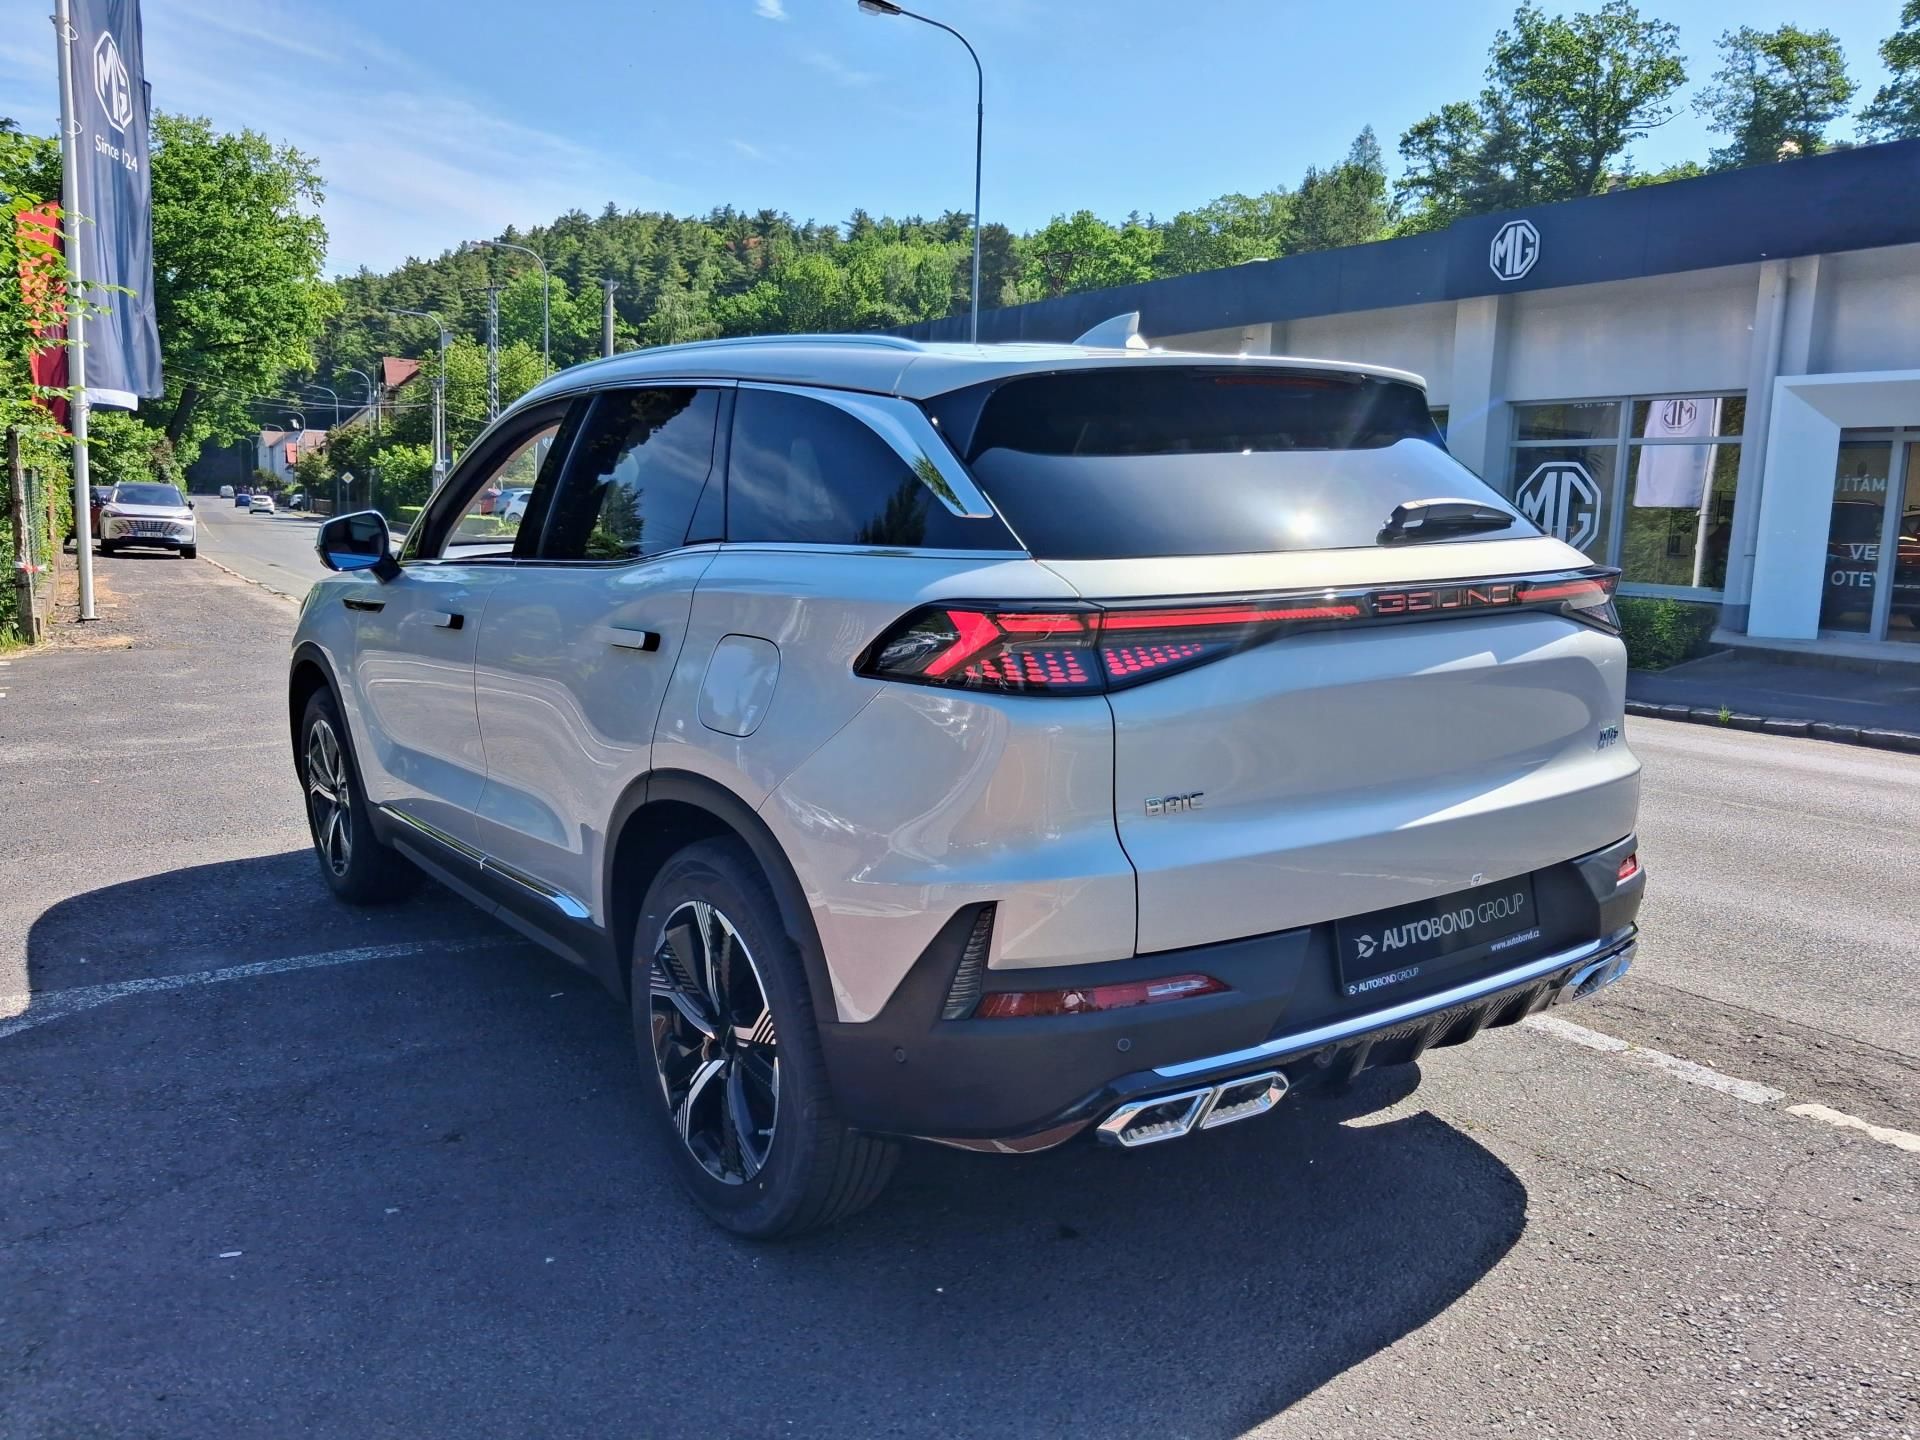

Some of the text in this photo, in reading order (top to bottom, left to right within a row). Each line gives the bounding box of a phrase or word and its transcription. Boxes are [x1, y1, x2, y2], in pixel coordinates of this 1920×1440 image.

[98, 36, 129, 124] MG
[95, 134, 120, 160] Since
[1494, 225, 1536, 275] MG
[1522, 472, 1593, 547] MG
[1145, 792, 1204, 816] BAIC
[1382, 893, 1524, 952] AUTOBOND GROUP
[1490, 930, 1540, 952] www.autobond.cz
[1358, 968, 1419, 993] AUTOBOND GROUP
